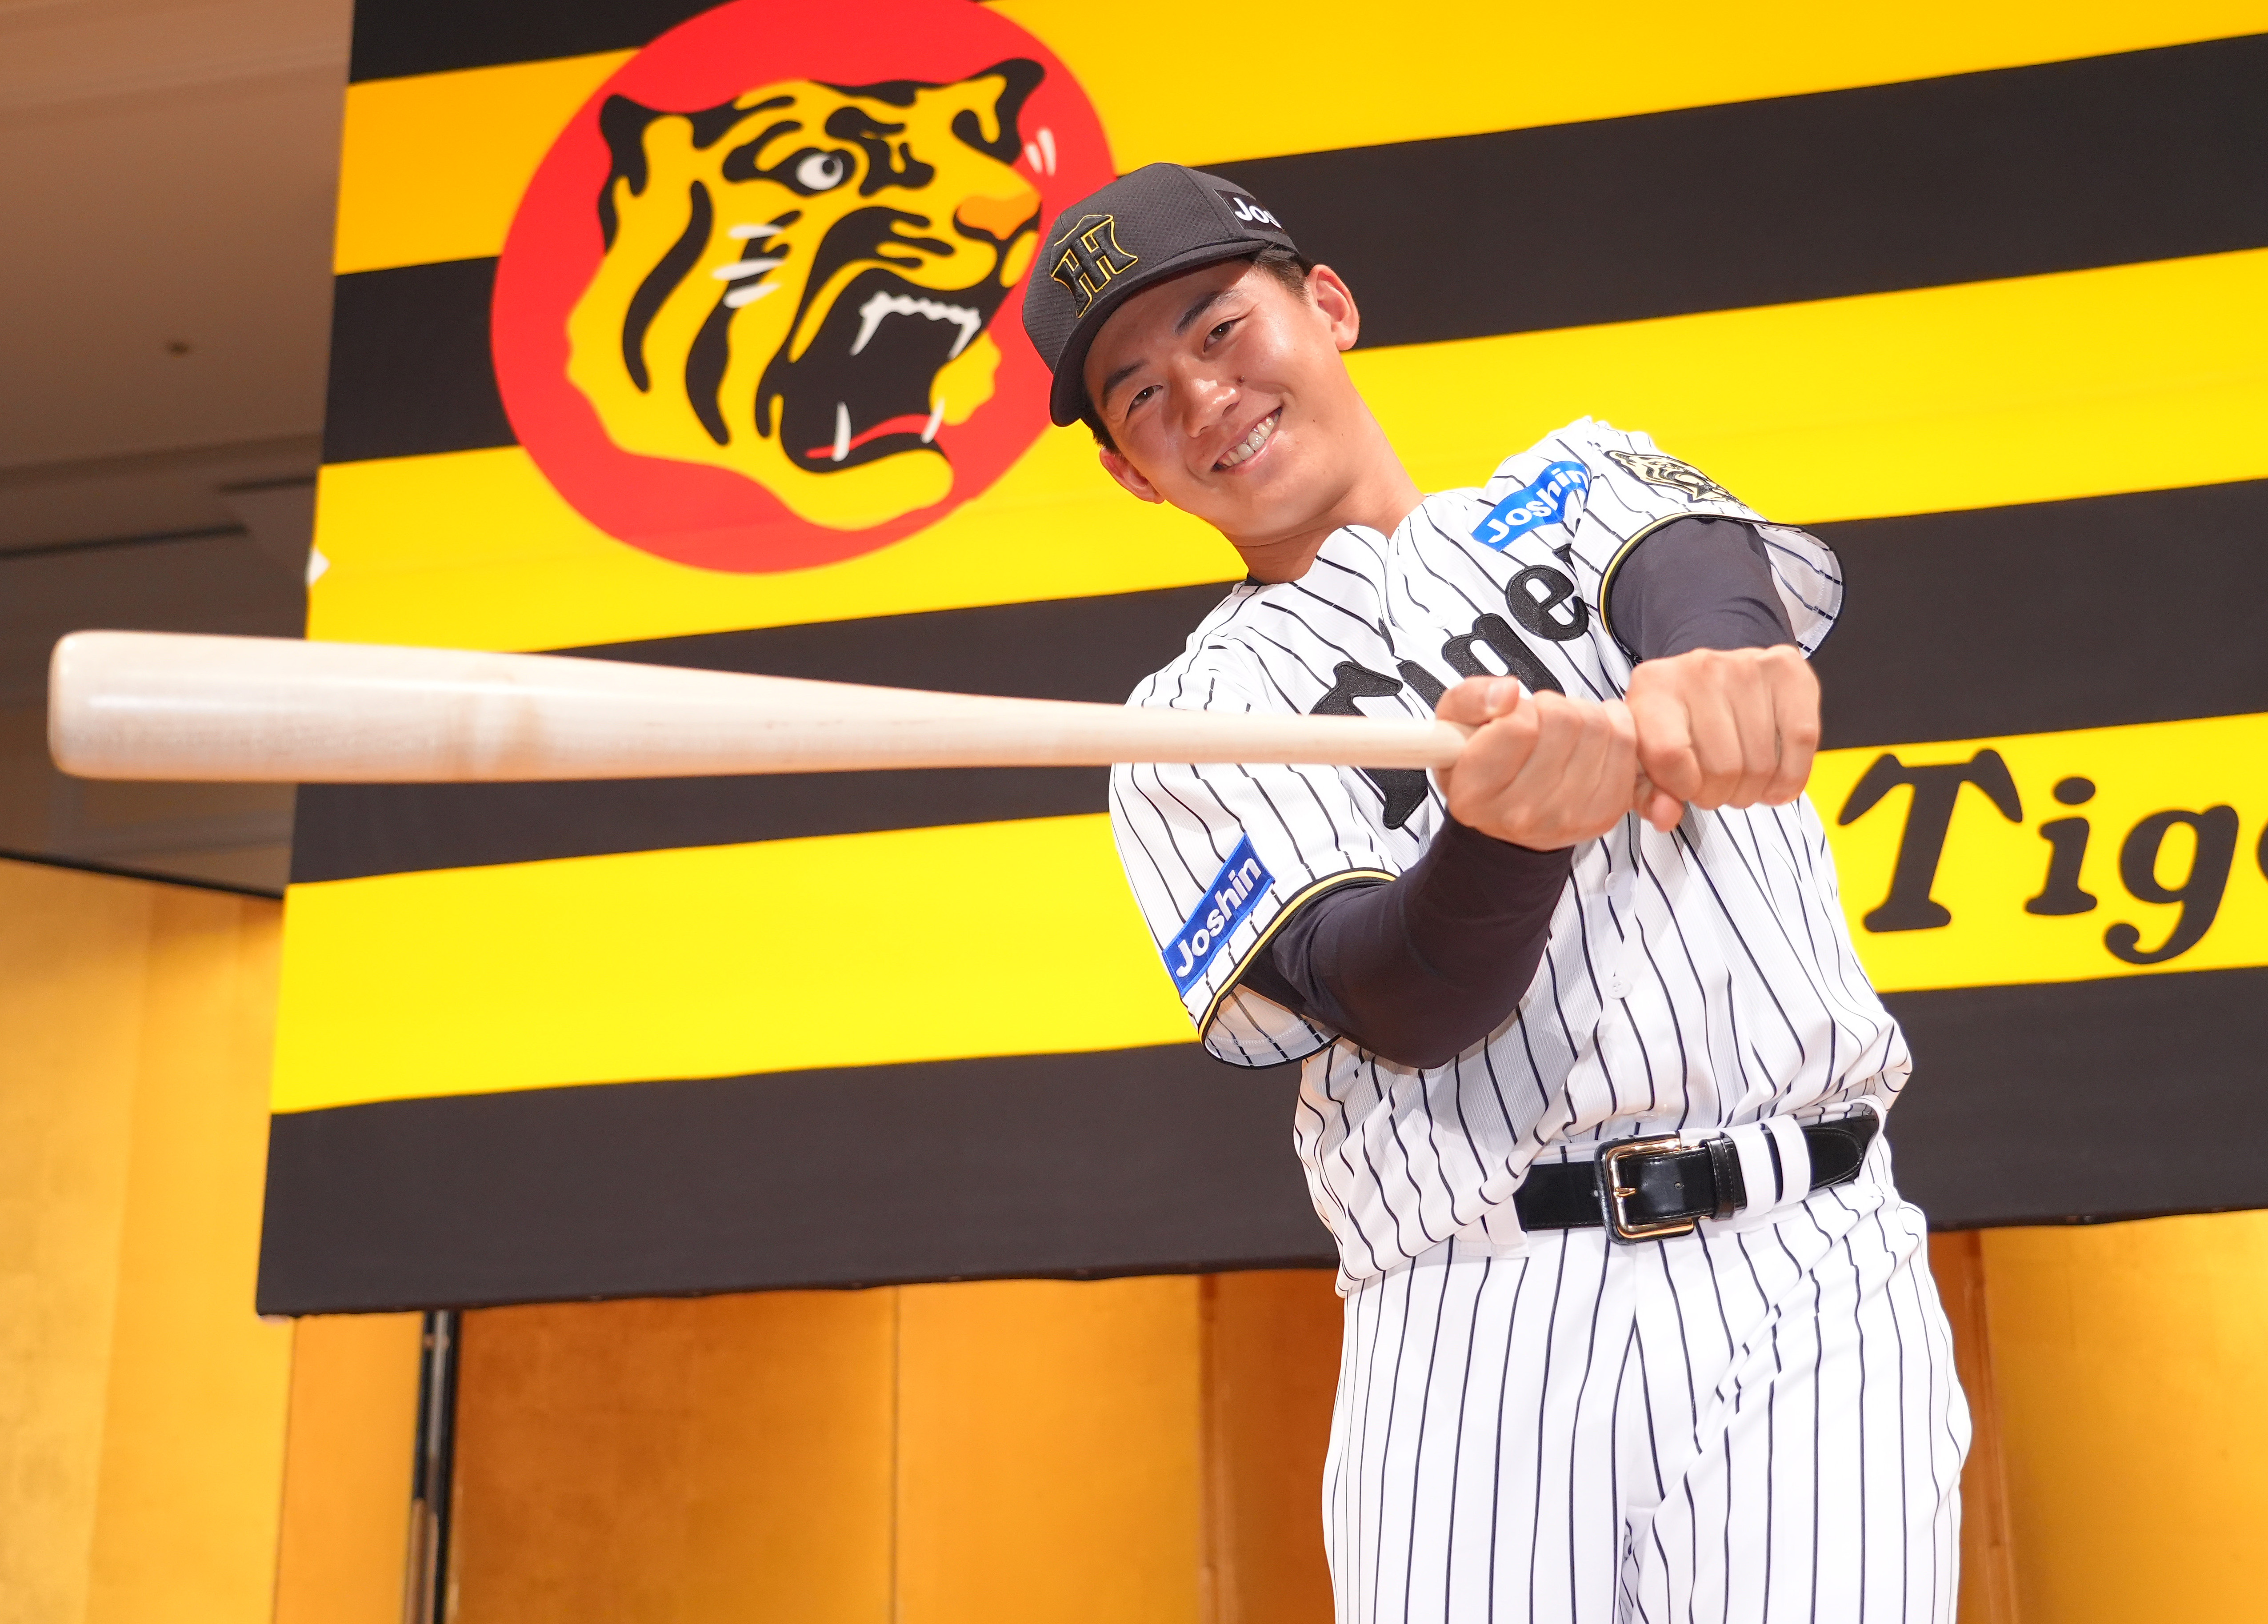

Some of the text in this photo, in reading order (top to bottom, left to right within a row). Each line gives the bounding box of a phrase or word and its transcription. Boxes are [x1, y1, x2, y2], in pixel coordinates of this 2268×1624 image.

[1487, 467, 1589, 543] Joshin
[1838, 748, 2268, 964] Tig
[1176, 858, 1262, 978] Joshin
